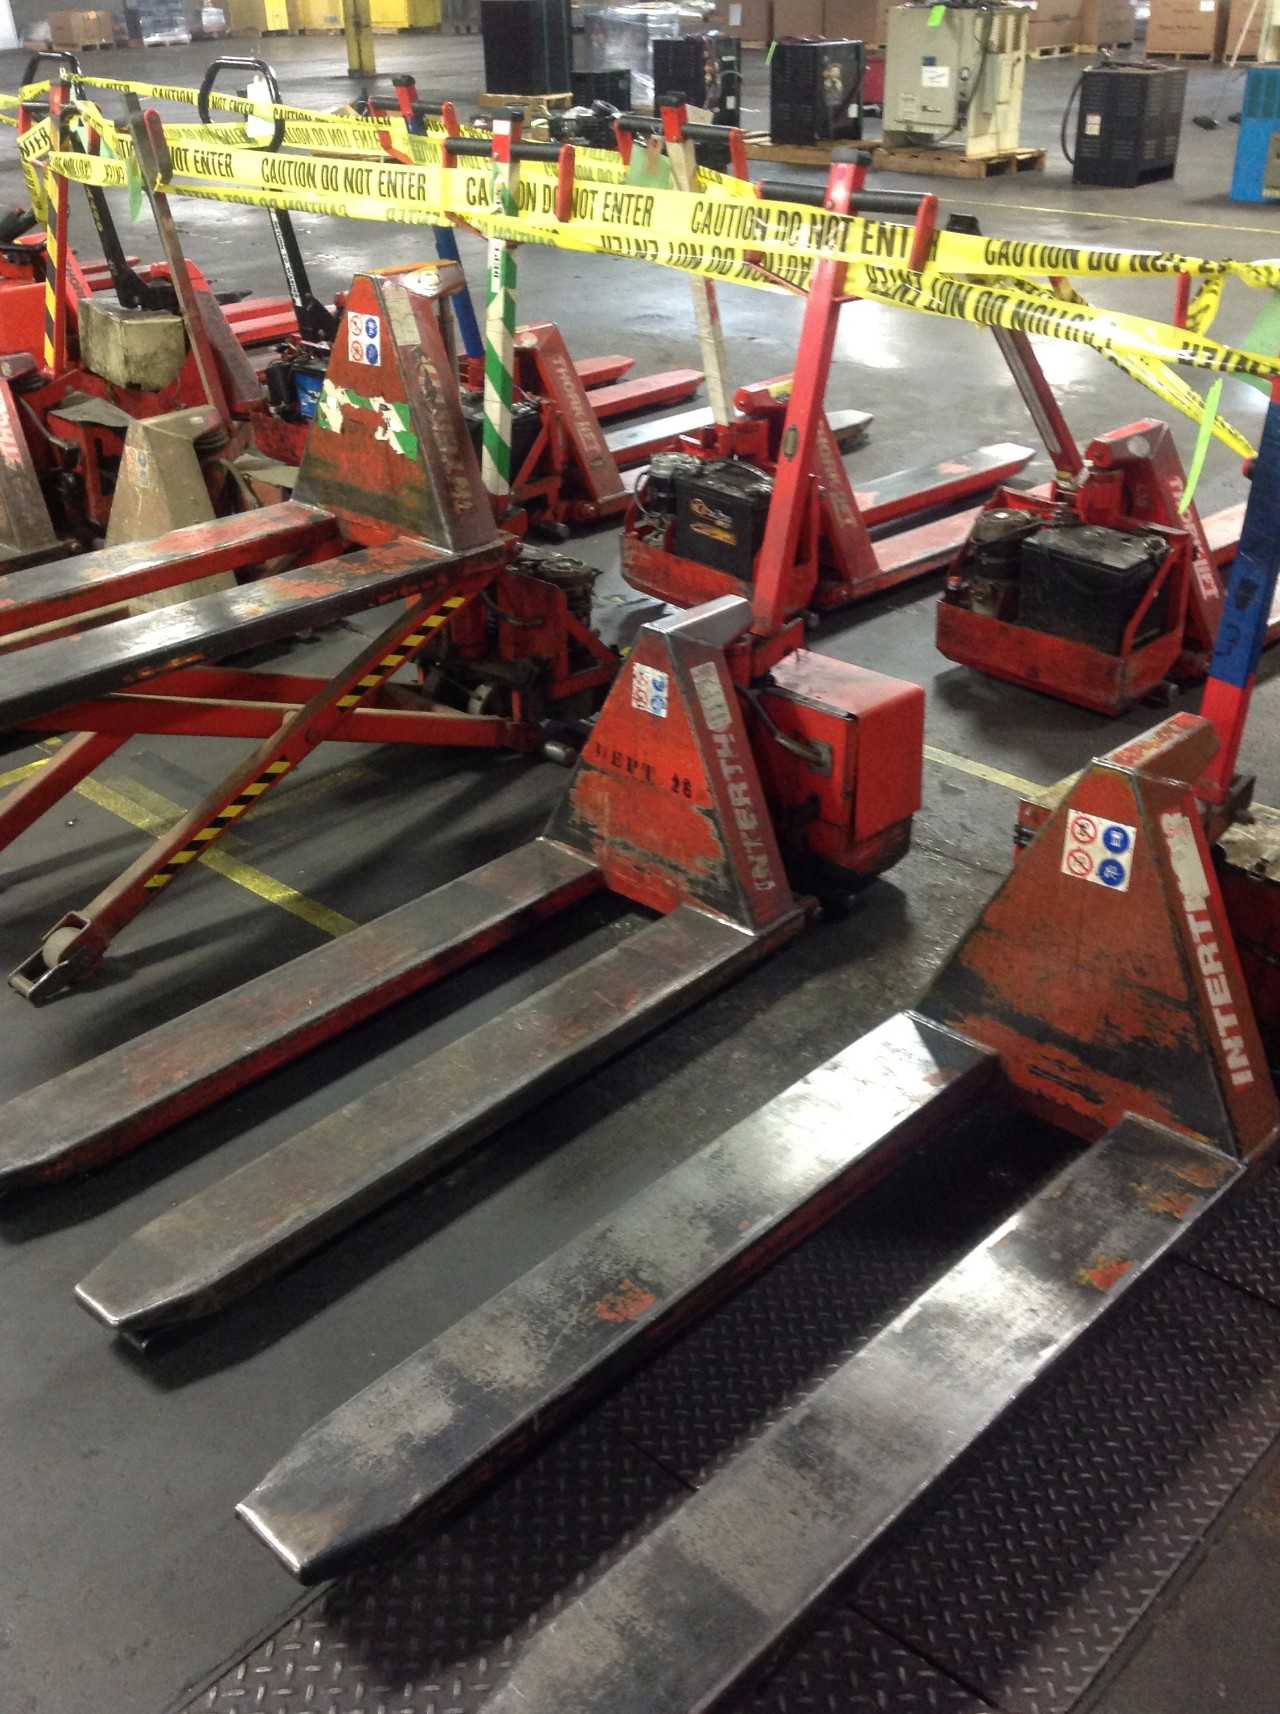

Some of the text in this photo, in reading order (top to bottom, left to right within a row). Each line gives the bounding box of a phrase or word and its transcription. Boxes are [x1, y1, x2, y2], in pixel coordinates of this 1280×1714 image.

[194, 150, 234, 178] ENTER
[262, 157, 316, 189] CAUTION
[321, 164, 339, 191] DO
[344, 166, 373, 195] NOT
[379, 169, 427, 201] ENTER
[466, 177, 536, 212] CAON
[602, 191, 655, 227] ENTER
[691, 201, 770, 242] CAUTION
[775, 210, 803, 247] DO
[808, 212, 854, 252] NOT
[985, 239, 1080, 270] CAUTION
[668, 241, 704, 269] NOT
[706, 246, 735, 275] DO
[924, 276, 974, 318] NOT
[974, 290, 1009, 325] DO
